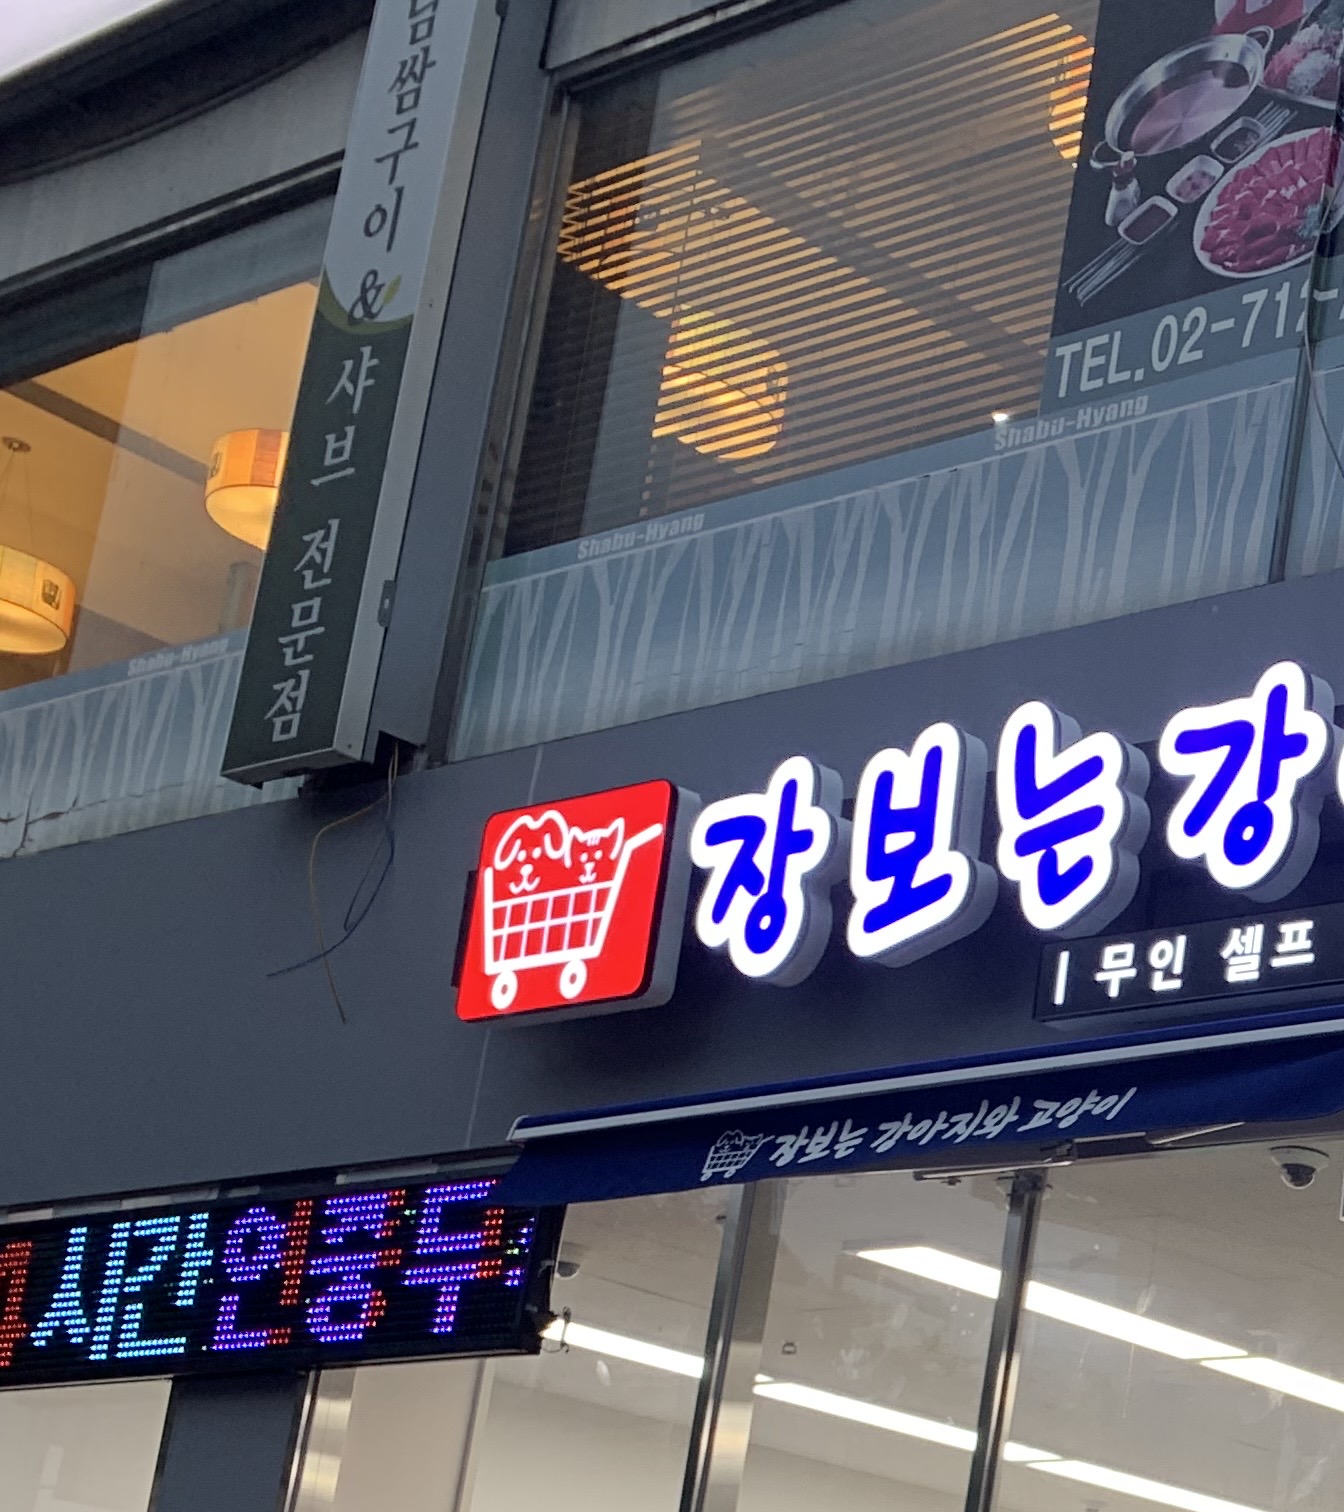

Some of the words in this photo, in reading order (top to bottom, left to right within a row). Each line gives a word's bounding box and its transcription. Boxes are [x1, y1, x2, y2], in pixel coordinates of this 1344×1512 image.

[347, 269, 386, 327] &
[311, 345, 380, 487] 샤브
[993, 393, 1149, 452] Shabu-Hyang
[575, 510, 706, 561] Shabu-Hyang
[264, 518, 341, 743] 전문점
[690, 700, 1124, 978] 장보는
[1092, 933, 1188, 999] 무인
[1219, 919, 1315, 984] 셀프
[769, 1117, 868, 1167] 장보는
[869, 1094, 1021, 1154] 강아지와
[1015, 1085, 1138, 1133] 고양이
